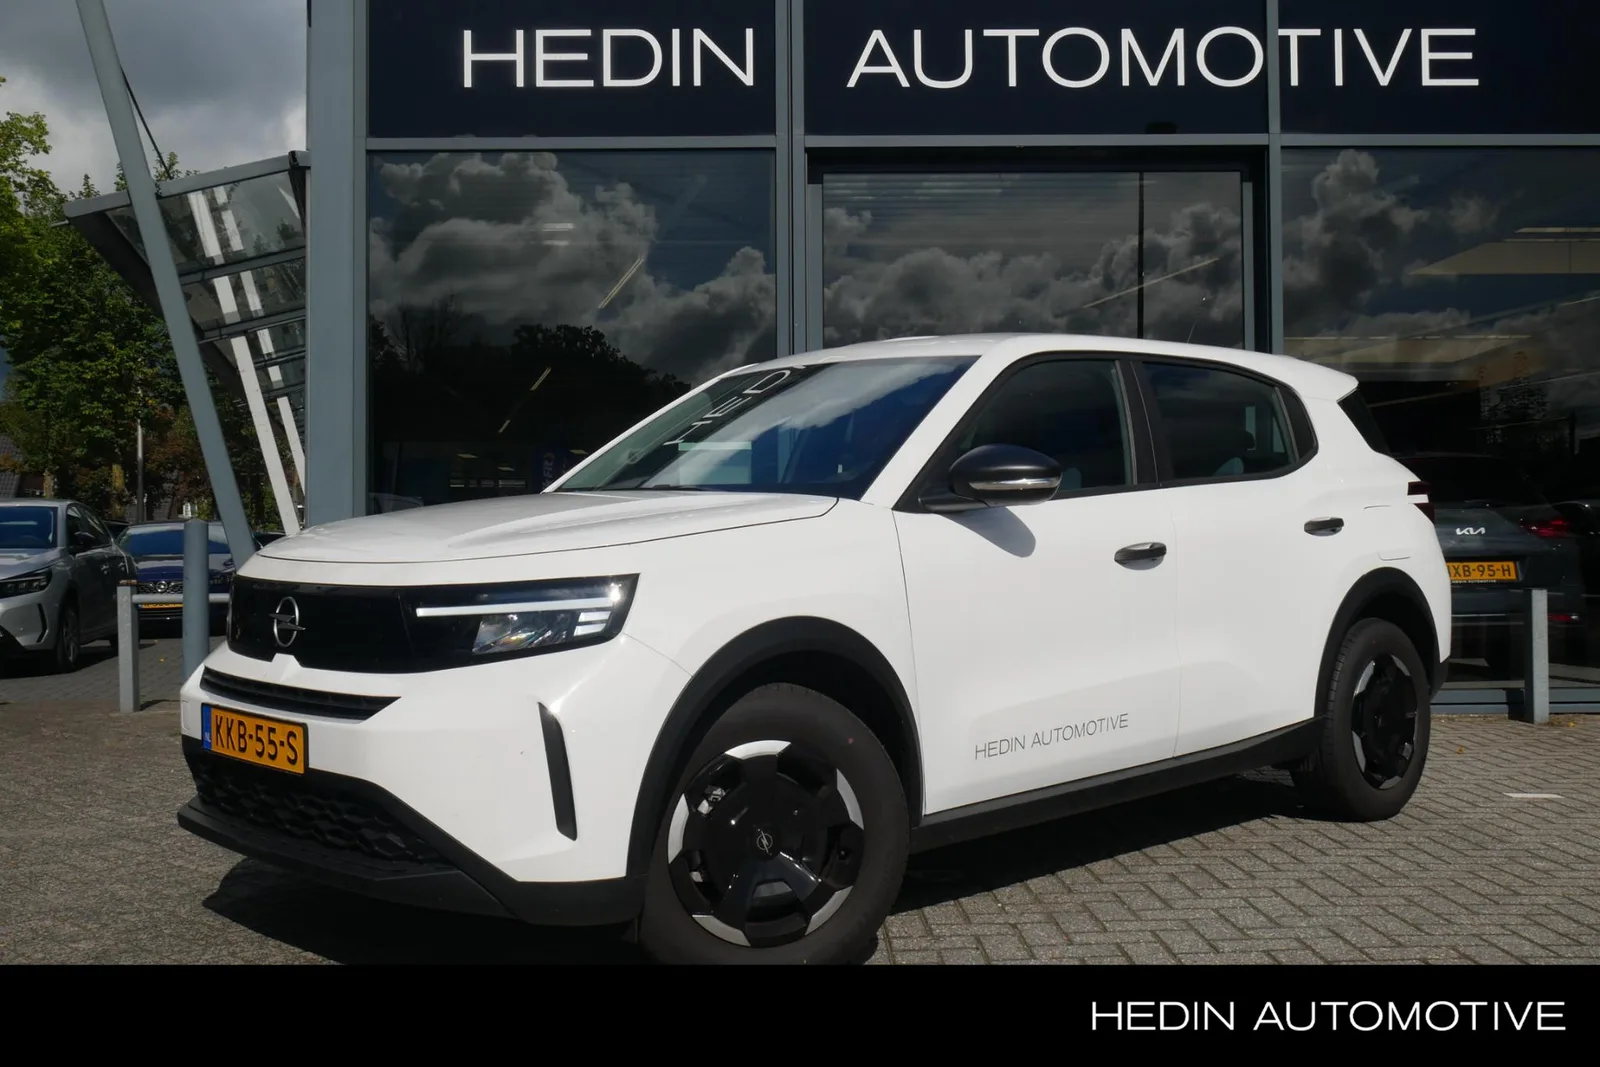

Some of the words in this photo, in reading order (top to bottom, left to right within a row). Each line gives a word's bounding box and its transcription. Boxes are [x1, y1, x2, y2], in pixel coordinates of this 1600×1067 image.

[463, 27, 754, 88] HEDIN
[846, 26, 1480, 89] AUTOMOTIVE
[215, 714, 299, 766] KKB-55-S
[975, 734, 1026, 760] HEDIN
[1030, 712, 1129, 748] AUTOMOTIVE
